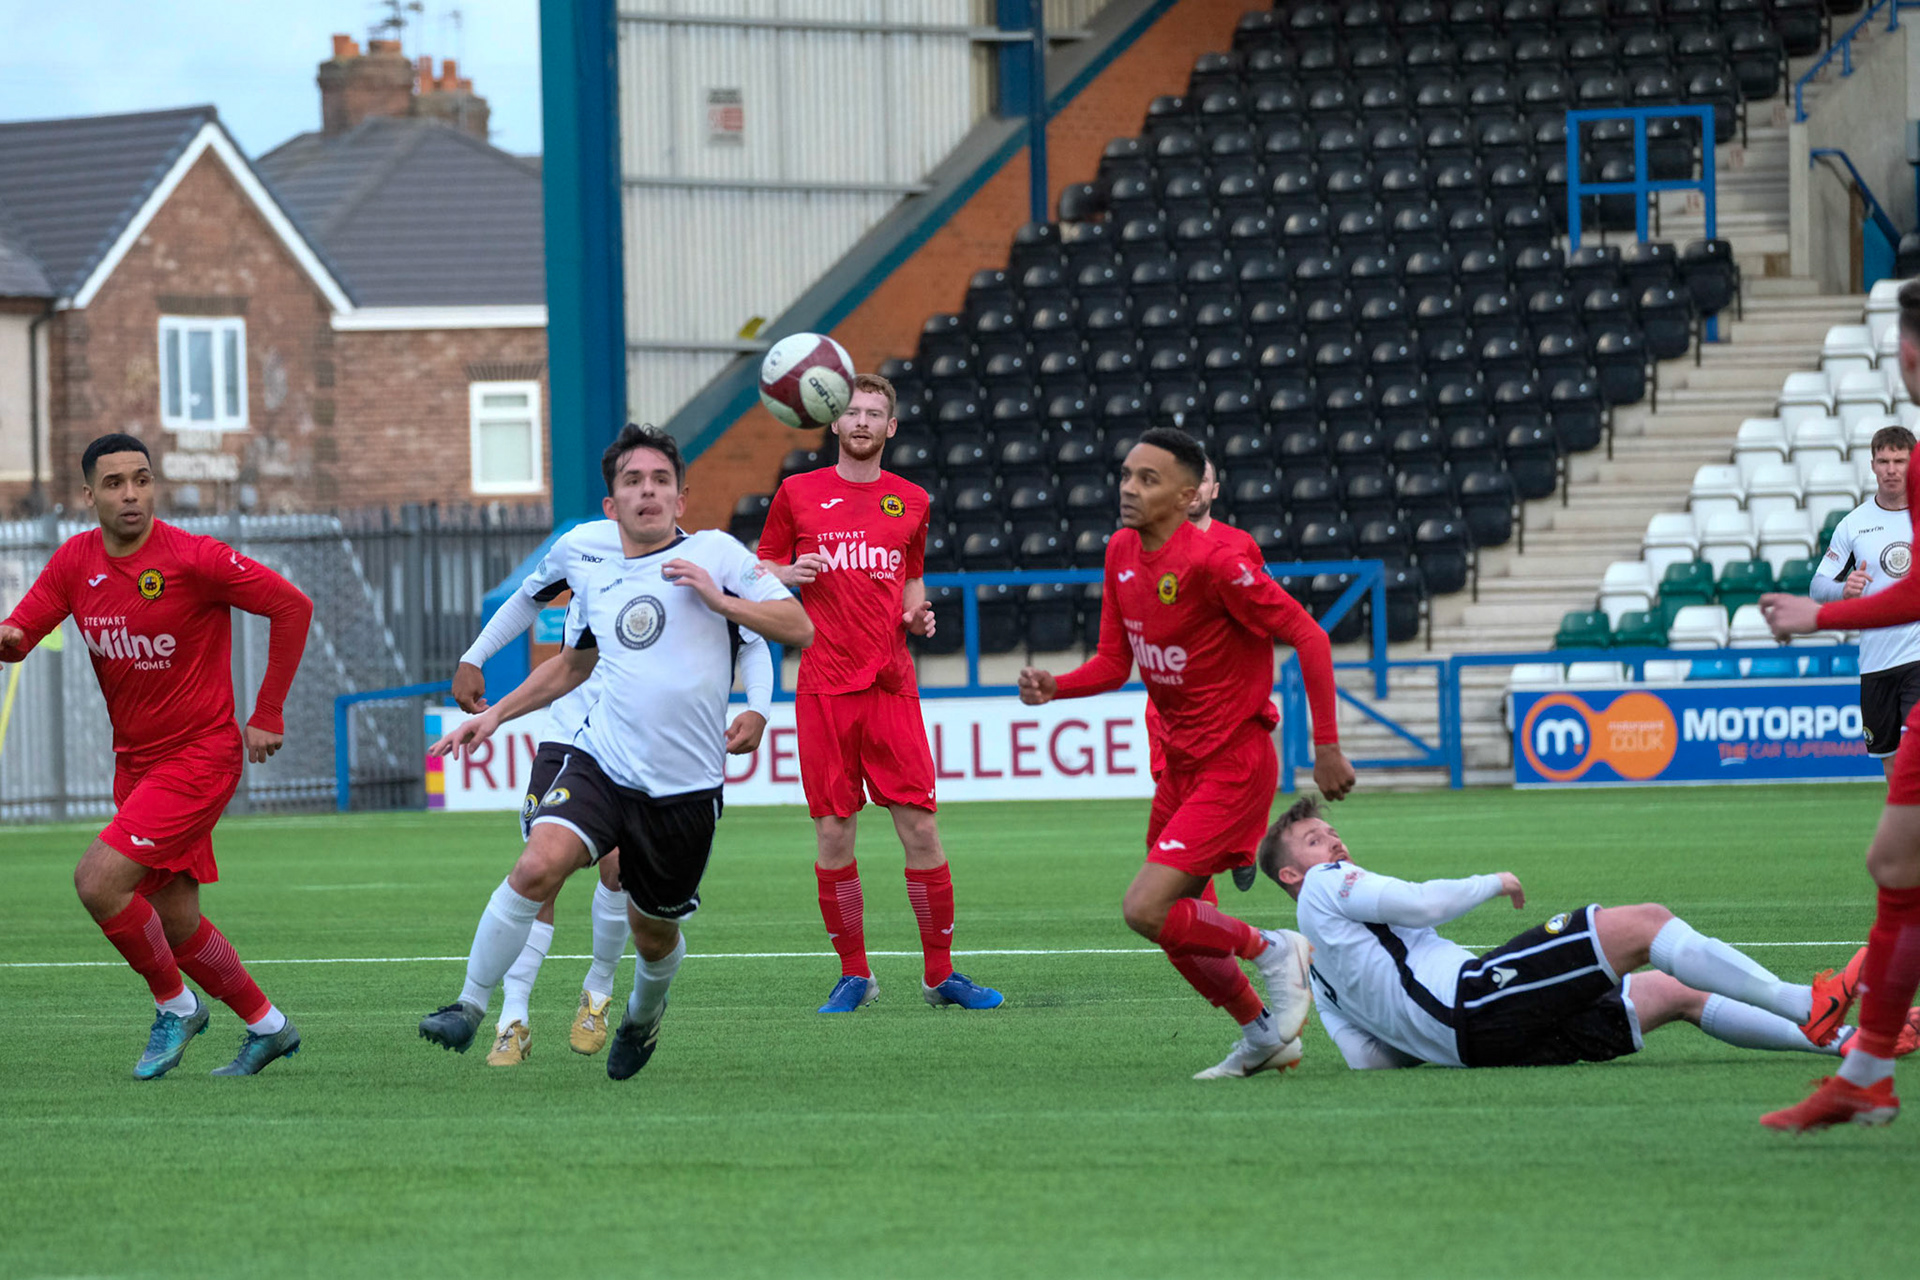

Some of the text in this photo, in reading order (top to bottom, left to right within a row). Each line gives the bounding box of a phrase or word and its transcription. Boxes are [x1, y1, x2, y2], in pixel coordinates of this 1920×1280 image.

[817, 530, 866, 543] STEWART
[818, 540, 902, 573] Milne
[83, 615, 127, 627] STEWART
[84, 626, 177, 661] Milne
[134, 659, 172, 671] HOMES
[1683, 705, 1864, 742] MOTORPO
